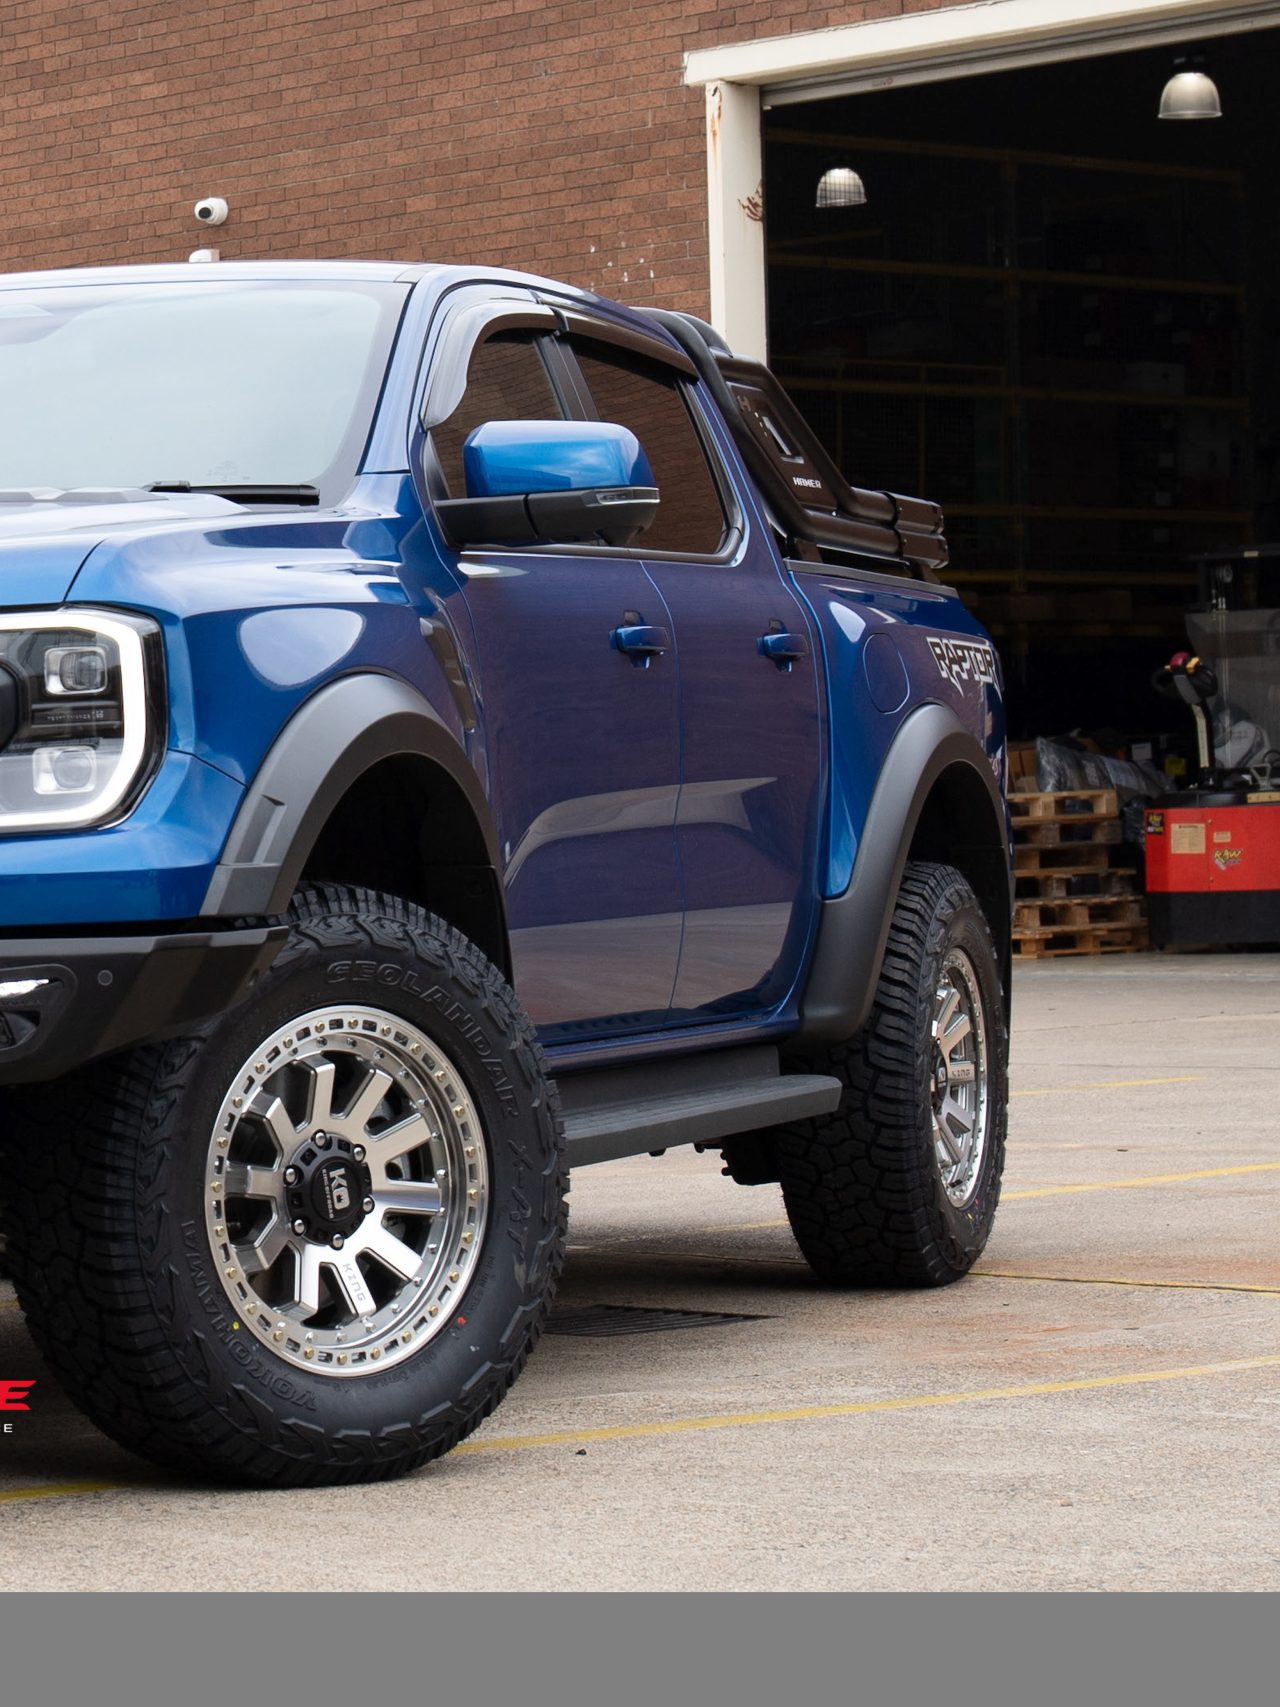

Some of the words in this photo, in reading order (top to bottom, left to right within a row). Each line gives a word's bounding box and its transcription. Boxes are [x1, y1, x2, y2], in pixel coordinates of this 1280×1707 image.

[792, 476, 822, 489] HAMER
[926, 636, 1002, 702] RAPTOR
[327, 960, 519, 1117] GEOLANDAR
[329, 1167, 350, 1210] KO
[342, 1263, 367, 1302] KING
[181, 1219, 318, 1411] YOKOHAMA
